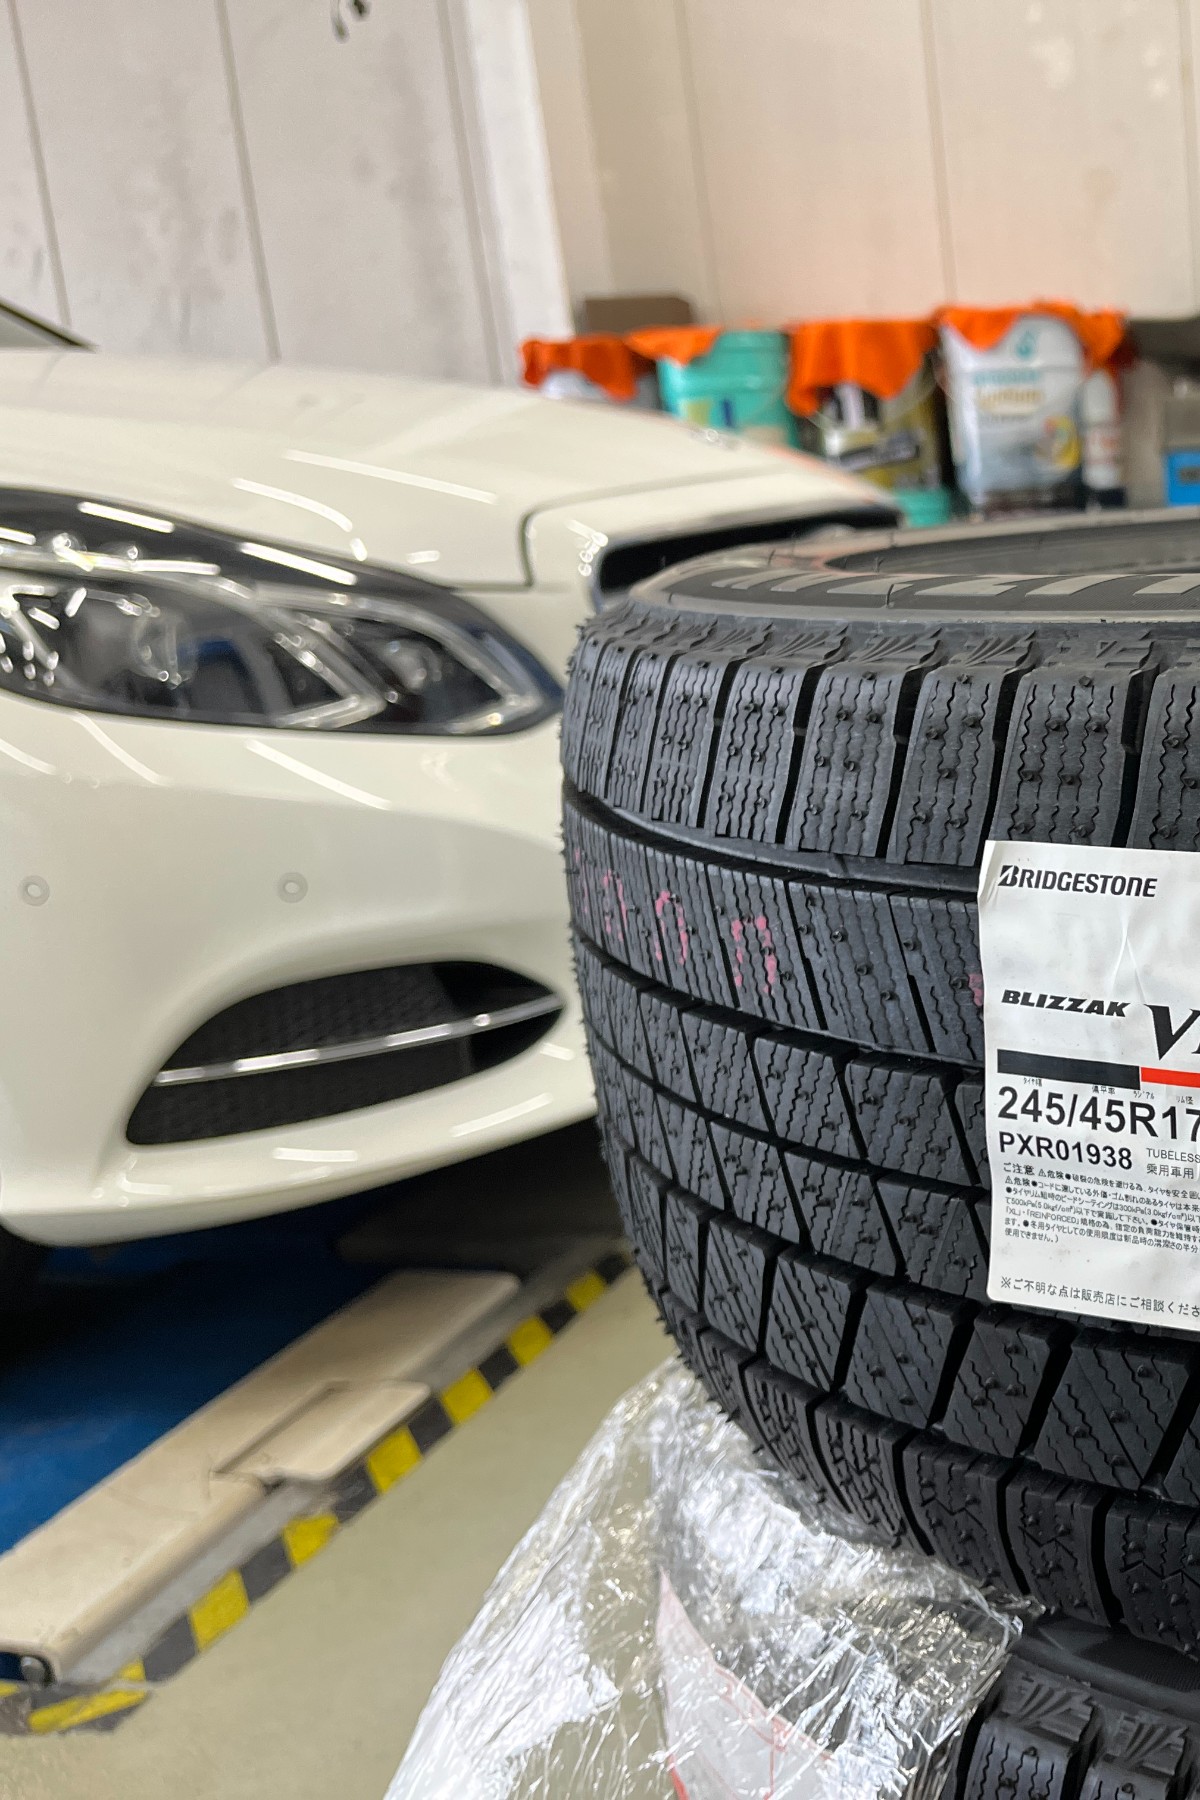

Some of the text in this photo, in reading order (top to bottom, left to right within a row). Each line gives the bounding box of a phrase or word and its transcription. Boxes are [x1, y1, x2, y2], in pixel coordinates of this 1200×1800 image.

[998, 865, 1157, 897] BRIDGESTONE
[1001, 990, 1131, 1018] BLIZZAK
[999, 1131, 1133, 1171] PXR01938
[1003, 1161, 1035, 1176] ご注意
[1145, 1164, 1195, 1181] 乗用車用
